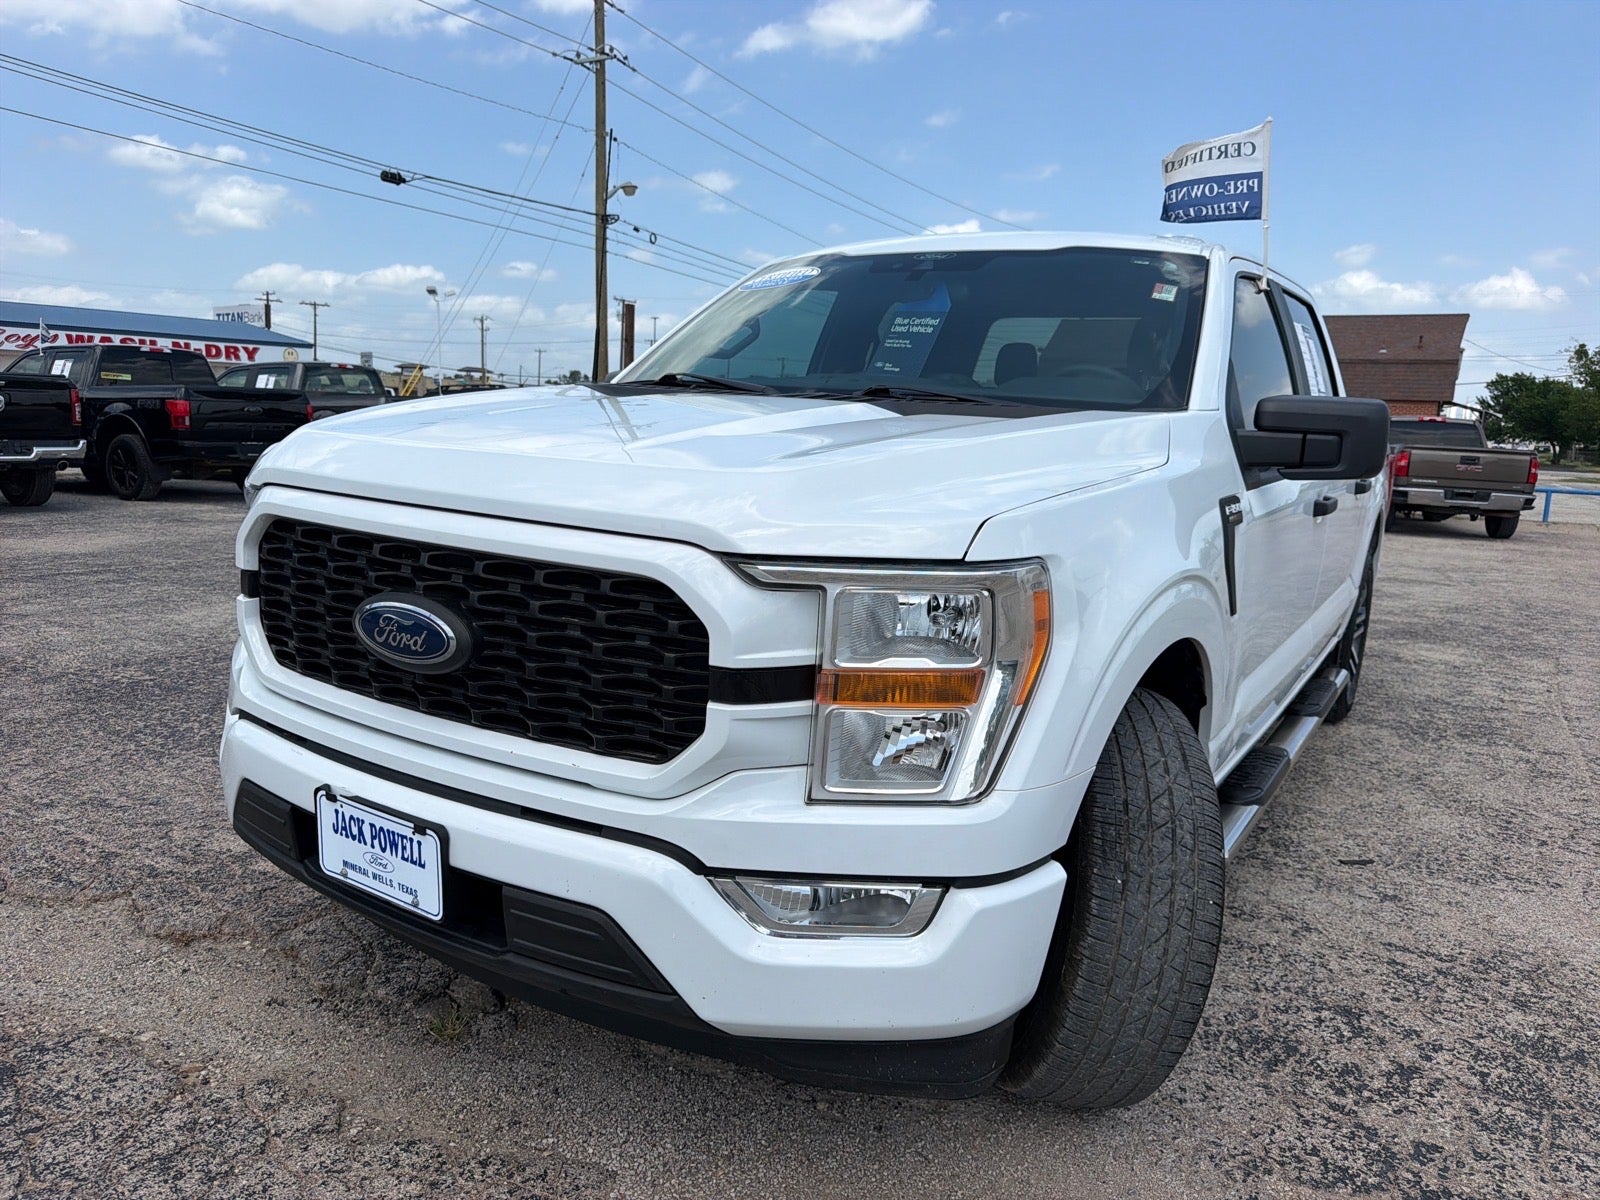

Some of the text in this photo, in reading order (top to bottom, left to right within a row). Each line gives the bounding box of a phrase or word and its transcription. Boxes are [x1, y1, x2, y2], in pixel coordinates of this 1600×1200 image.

[894, 317, 940, 326] Blue Certified
[909, 325, 934, 333] Vehicle
[374, 613, 428, 652] Ford
[332, 808, 425, 869] JACK POWELL
[368, 854, 390, 871] Ford
[342, 859, 419, 899] MINERAL WELLS, TEXAS
